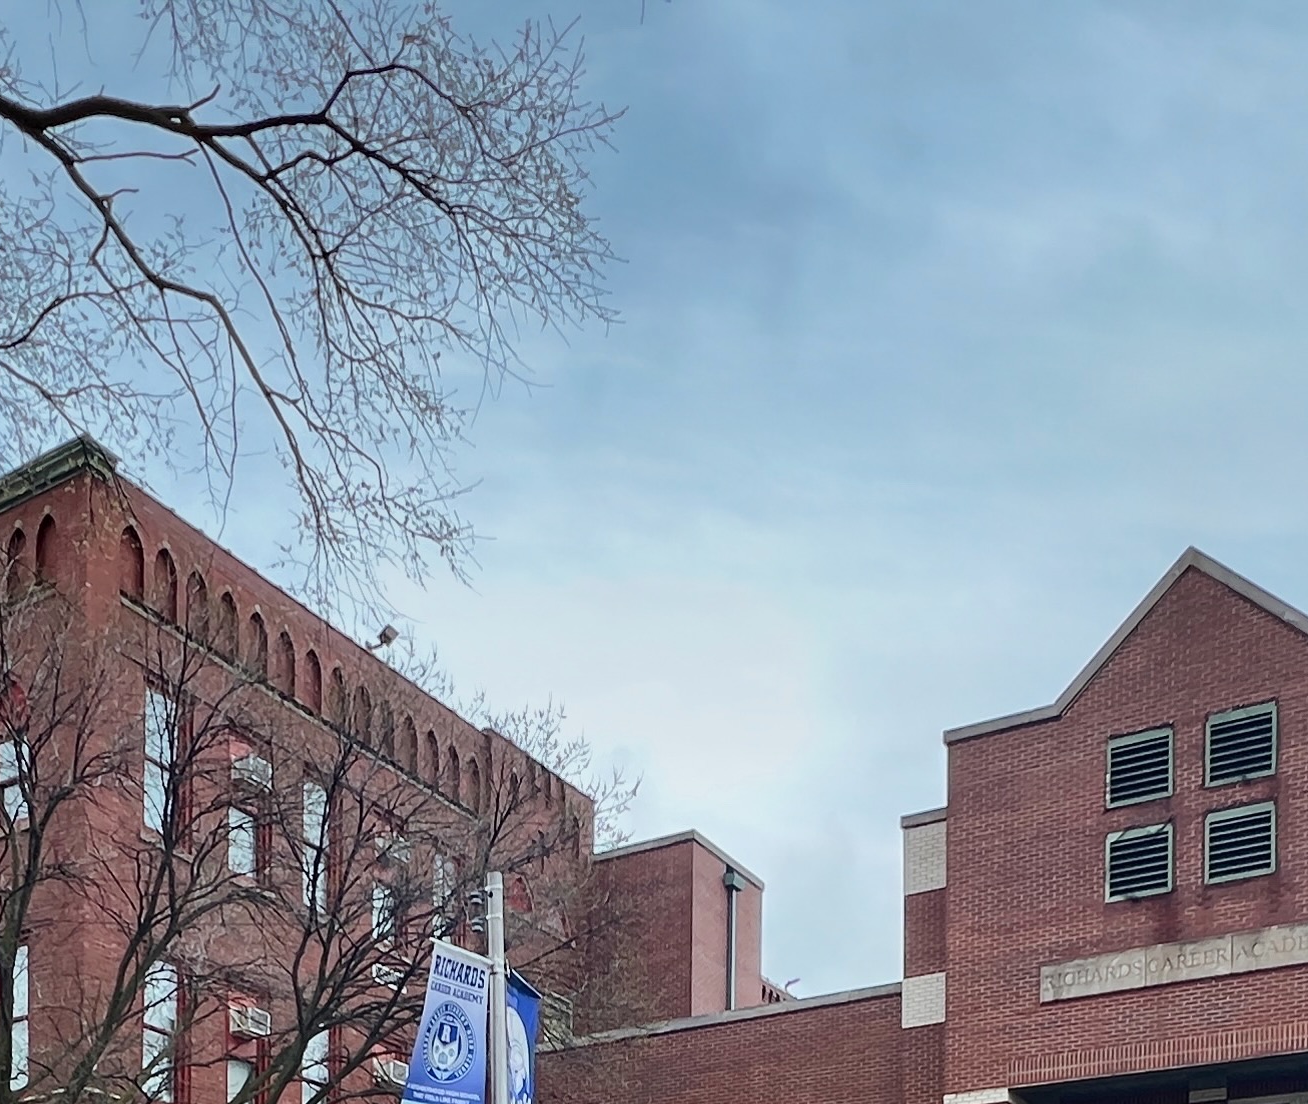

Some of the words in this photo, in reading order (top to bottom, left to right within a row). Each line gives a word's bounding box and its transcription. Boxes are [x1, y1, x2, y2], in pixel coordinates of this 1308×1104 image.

[433, 954, 486, 989] RICHARDS
[1044, 958, 1142, 992] RICHARDS
[1148, 948, 1229, 974] CAREER
